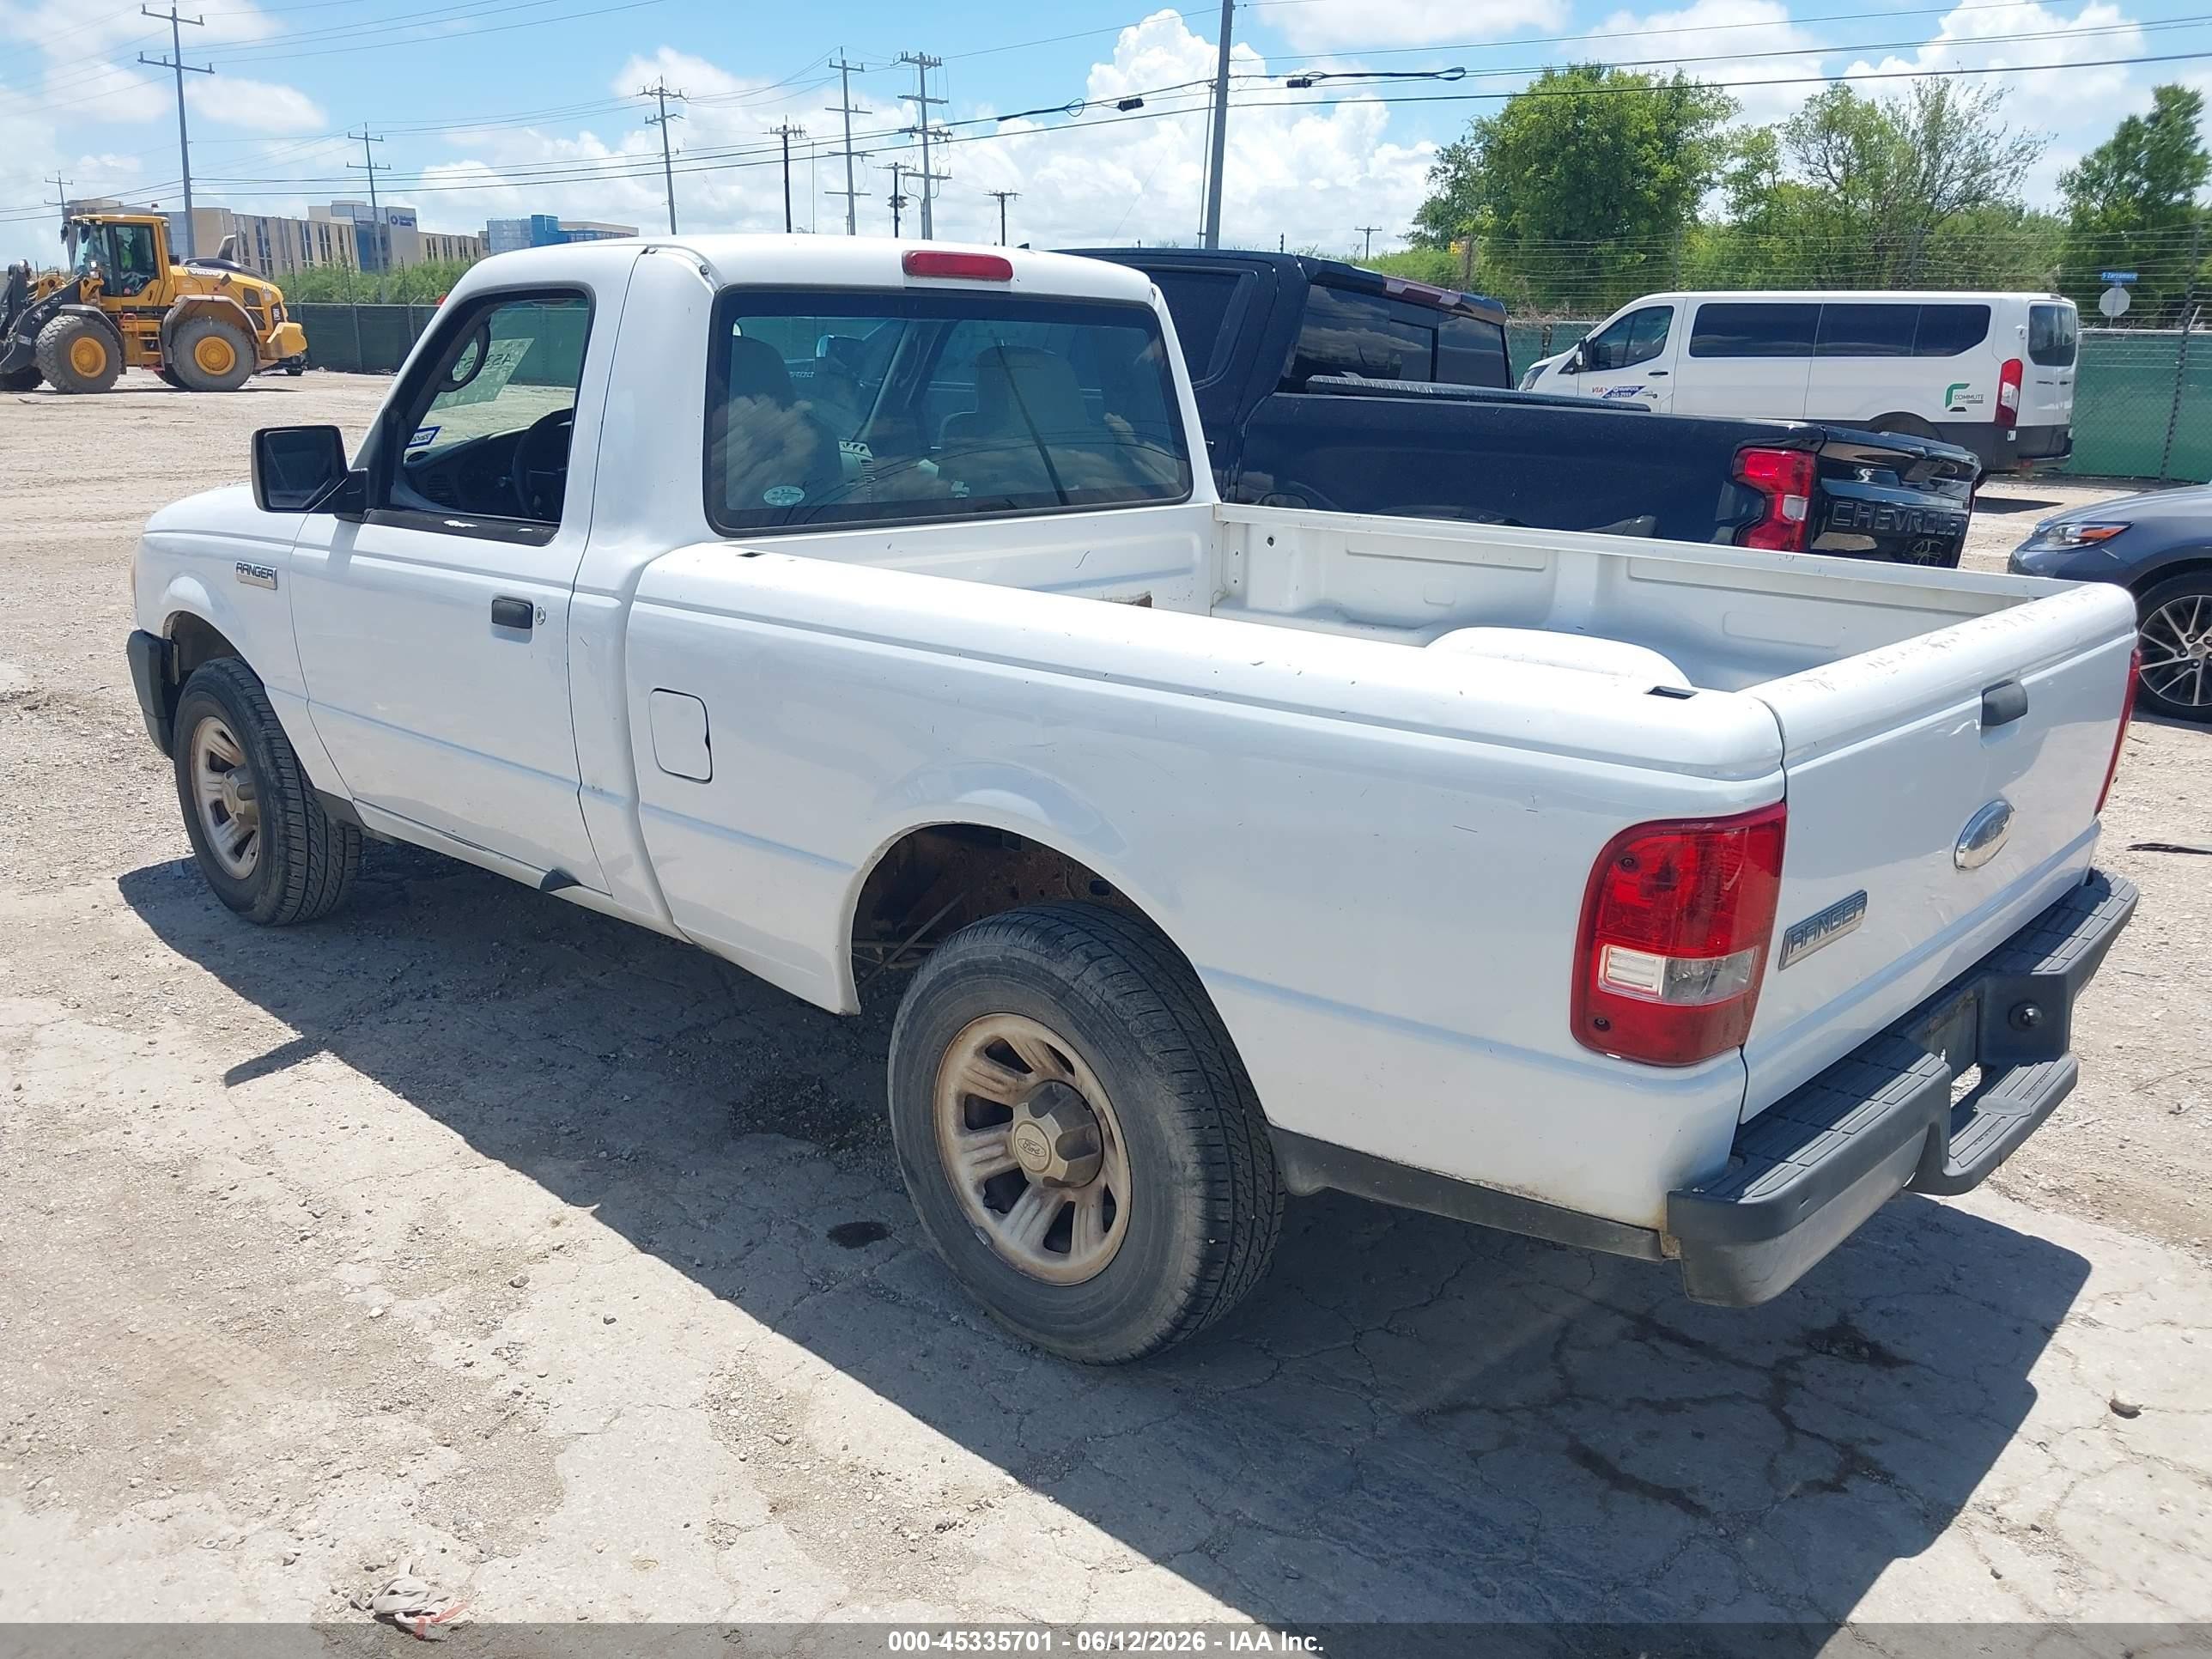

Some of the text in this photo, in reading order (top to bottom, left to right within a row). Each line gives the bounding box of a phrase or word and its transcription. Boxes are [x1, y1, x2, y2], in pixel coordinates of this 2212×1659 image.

[188, 268, 220, 276] VOLVO
[235, 562, 274, 581] RANGER
[1789, 894, 1866, 956] RANGER
[1022, 1139, 1042, 1155] Ford
